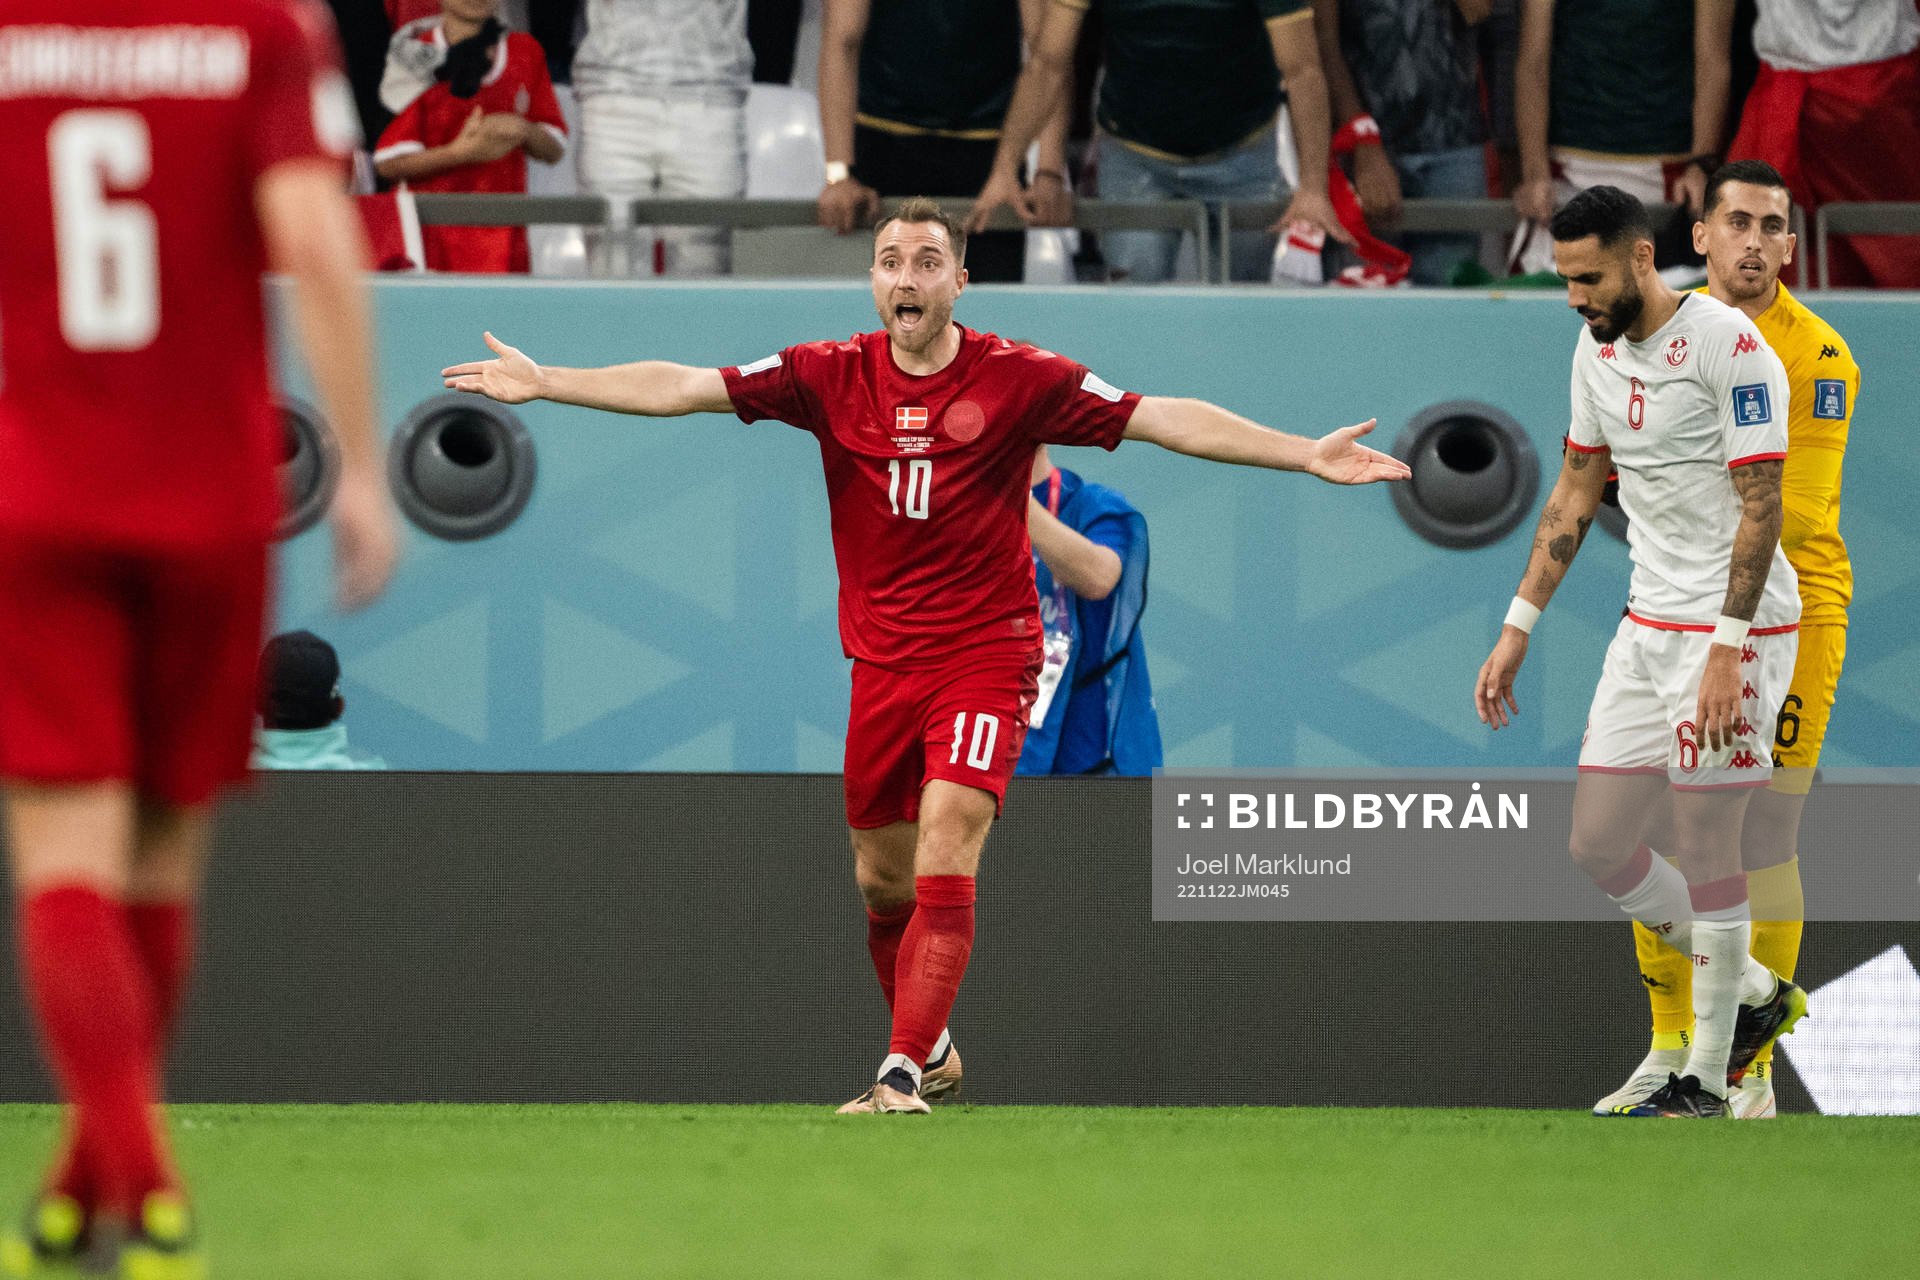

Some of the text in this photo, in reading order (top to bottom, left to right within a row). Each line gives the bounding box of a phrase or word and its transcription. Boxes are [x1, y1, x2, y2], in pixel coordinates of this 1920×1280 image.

[47, 107, 162, 353] 6
[1628, 376, 1646, 430] 6
[888, 459, 932, 520] 10
[949, 711, 999, 771] 10
[1676, 720, 1698, 773] 6
[1775, 694, 1802, 748] 6
[1650, 920, 1672, 936] TF
